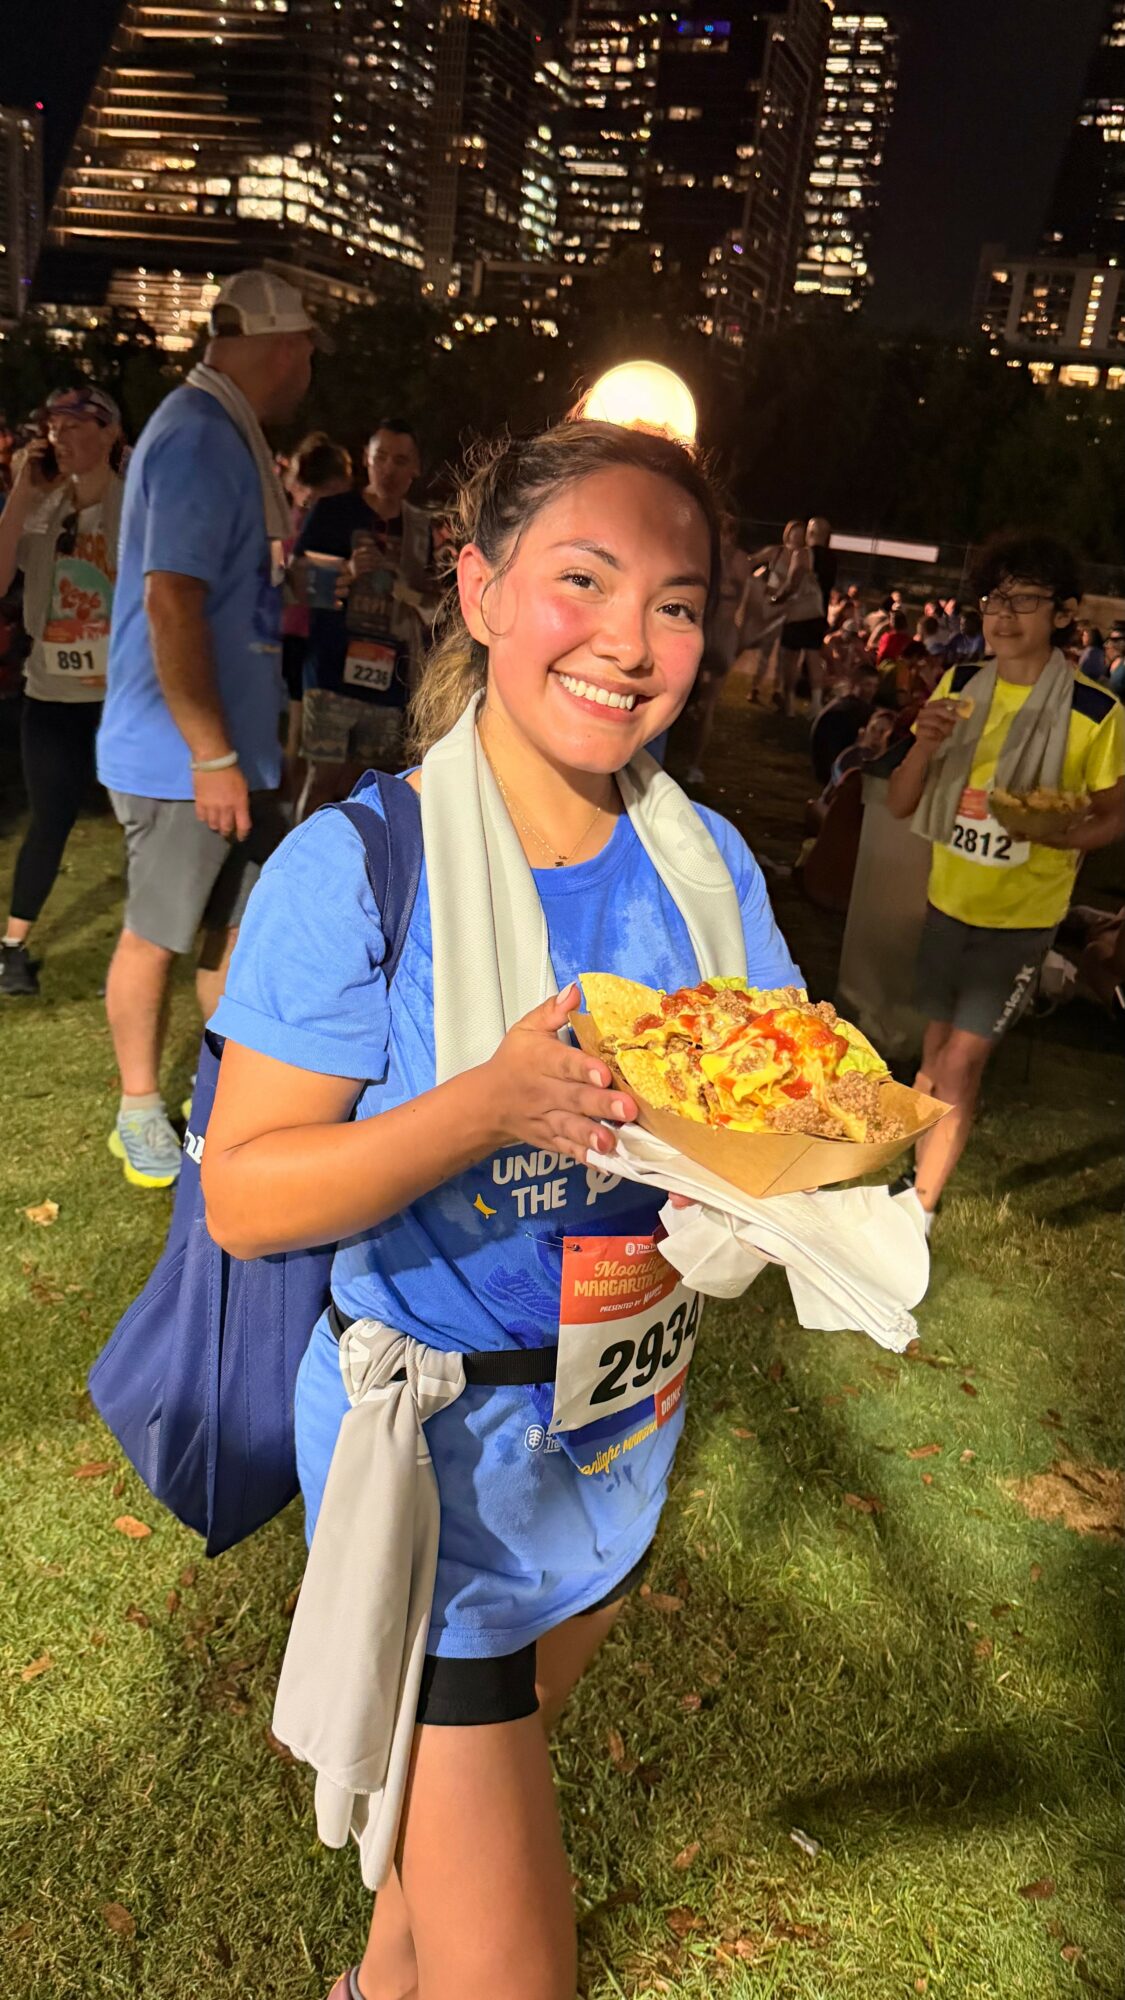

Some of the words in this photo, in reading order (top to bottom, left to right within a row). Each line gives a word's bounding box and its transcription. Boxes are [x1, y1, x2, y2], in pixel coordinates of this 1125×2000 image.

[57, 650, 95, 670] 891
[953, 825, 1013, 860] 2812
[492, 1150, 584, 1185] UNDE
[511, 1177, 568, 1218] THE
[590, 1291, 699, 1405] 2934
